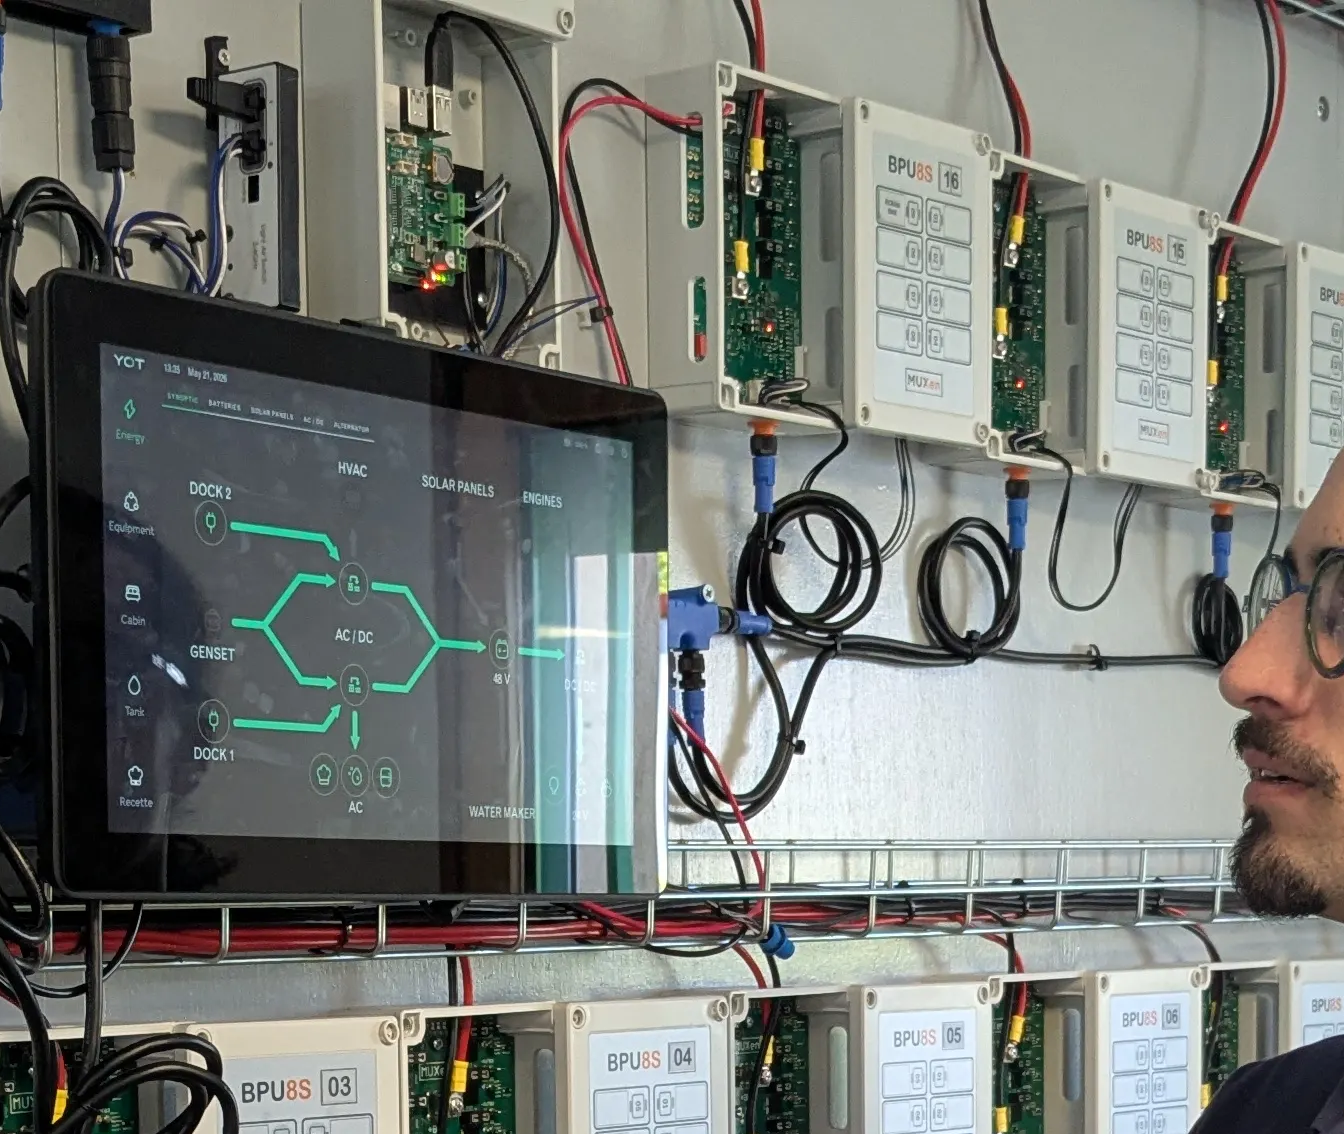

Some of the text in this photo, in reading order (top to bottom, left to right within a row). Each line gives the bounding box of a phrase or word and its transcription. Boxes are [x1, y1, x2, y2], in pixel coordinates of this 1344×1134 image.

[888, 155, 959, 189] BPU8S 16
[1126, 228, 1185, 260] BPU8S 15
[338, 461, 367, 478] HVAC
[189, 481, 232, 500] DOCK 2
[421, 474, 495, 498] SOLAR PANELS
[522, 490, 563, 509] ENGINES
[108, 520, 155, 537] Equipment
[121, 614, 146, 627] Cabin
[335, 628, 351, 642] AC
[359, 630, 374, 644] DC
[190, 645, 236, 662] GENSET
[125, 705, 145, 717] Tank
[193, 746, 235, 761] DOCK 1
[119, 797, 154, 808] Recette
[348, 801, 364, 814] AC
[469, 805, 536, 820] WATER MAKER
[1166, 1009, 1178, 1024] 06
[893, 1027, 962, 1048] BPU8S 05
[607, 1047, 692, 1072] BPU8S 04
[241, 1076, 351, 1103] BPU8S 03
